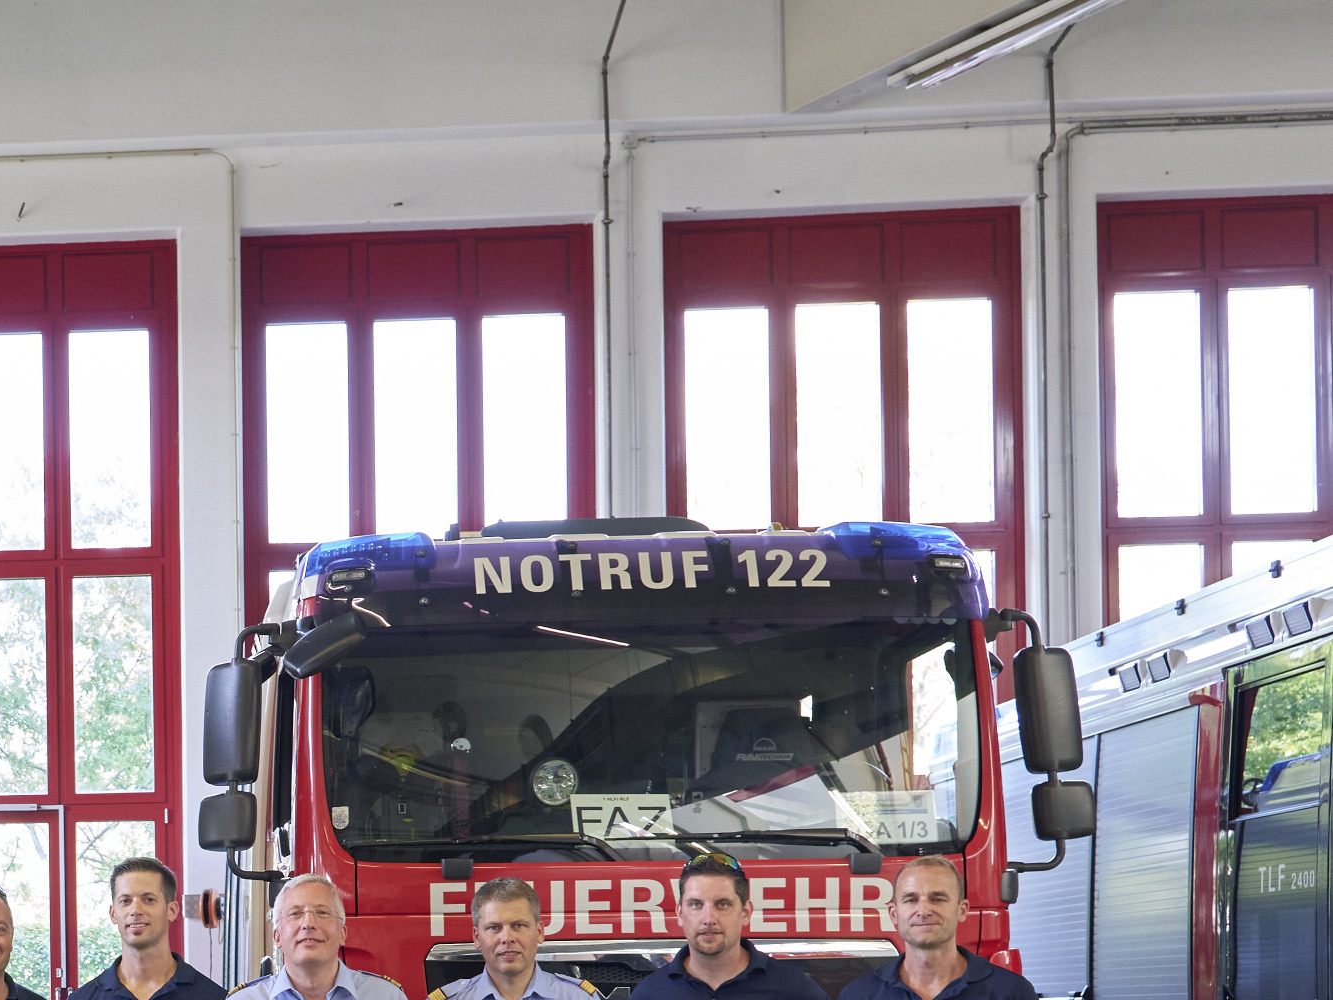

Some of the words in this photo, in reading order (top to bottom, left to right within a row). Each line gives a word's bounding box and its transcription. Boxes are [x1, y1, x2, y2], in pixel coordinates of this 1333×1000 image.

[473, 550, 710, 595] NOTRUF
[738, 548, 831, 588] 122
[897, 820, 929, 840] 1/3
[1258, 863, 1286, 893] TLF
[1291, 870, 1315, 890] 2400
